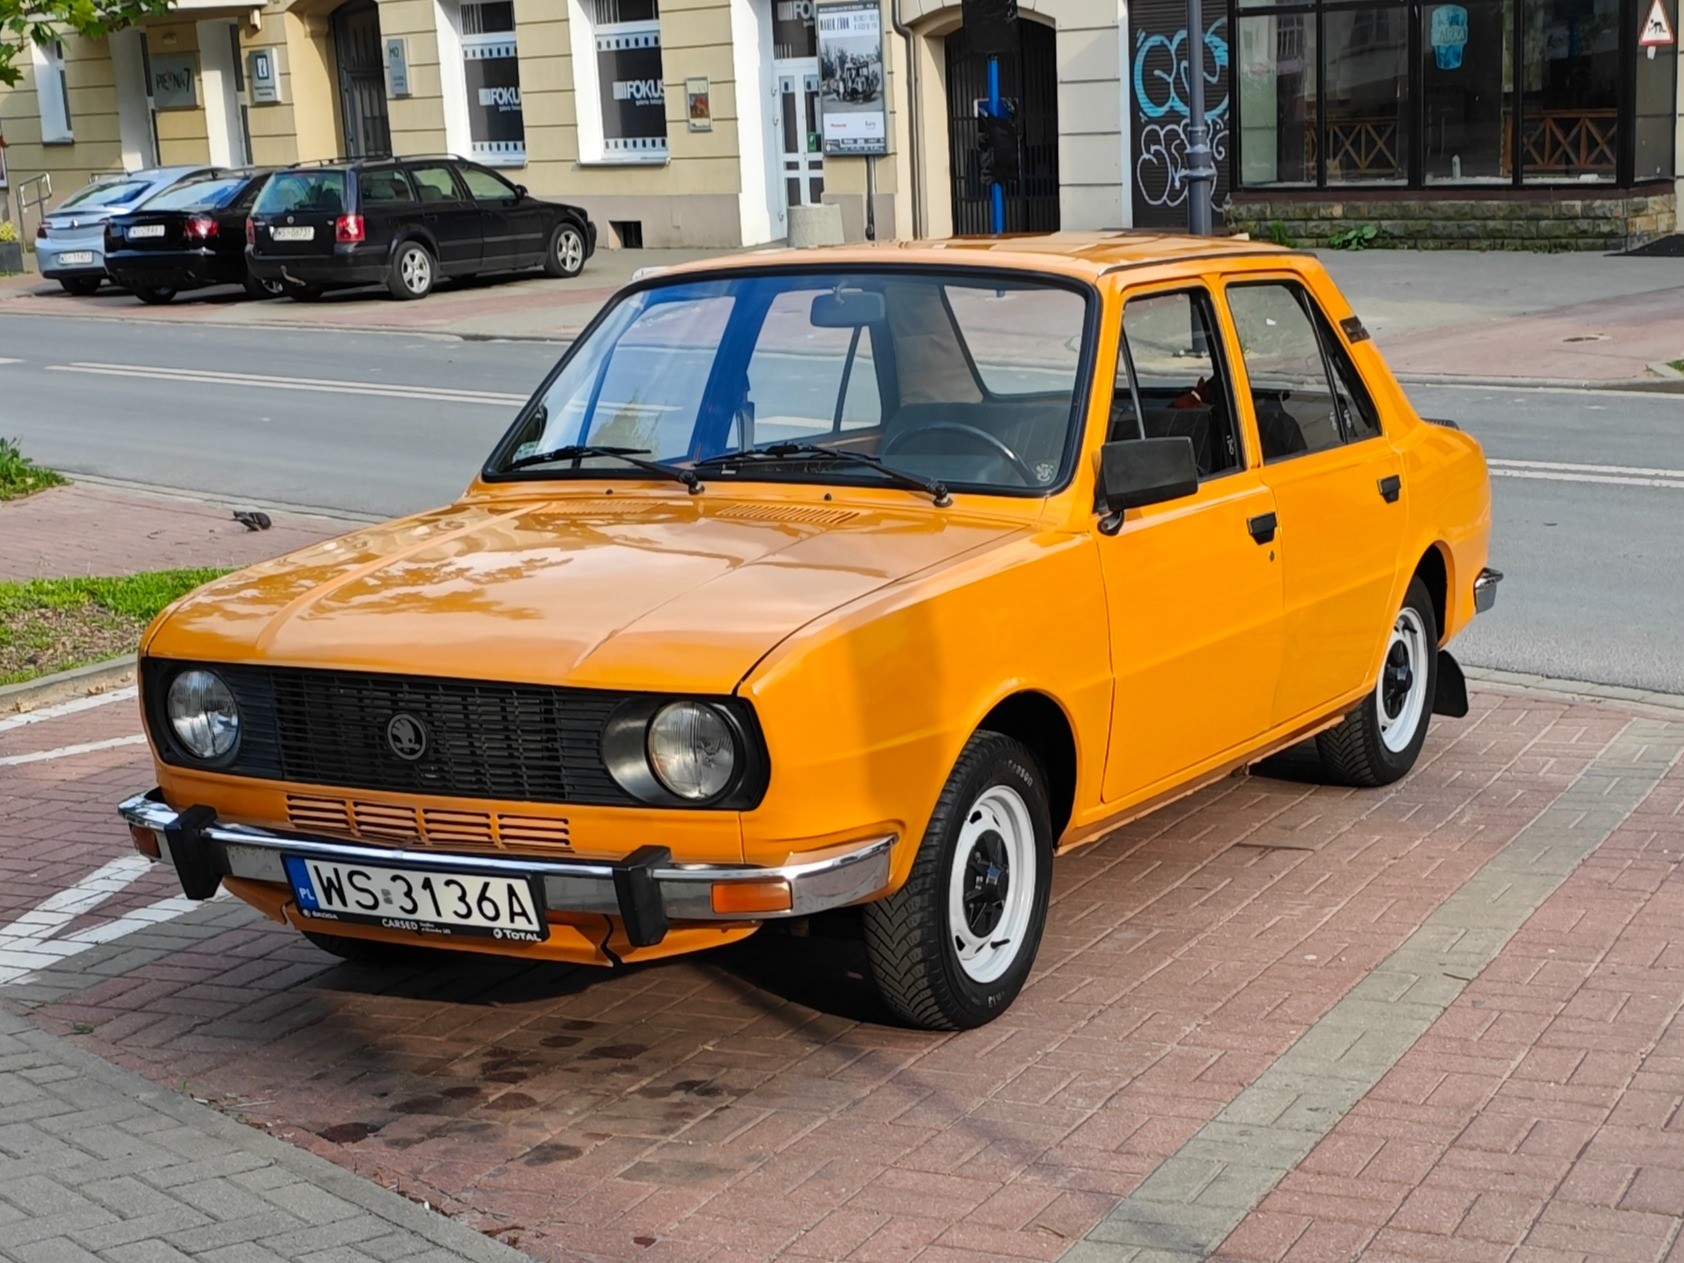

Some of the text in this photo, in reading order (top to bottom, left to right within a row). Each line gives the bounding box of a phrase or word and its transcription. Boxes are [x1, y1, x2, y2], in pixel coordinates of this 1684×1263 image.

[299, 887, 315, 901] PL
[313, 865, 533, 925] WS 3136A
[381, 918, 418, 930] CARSED
